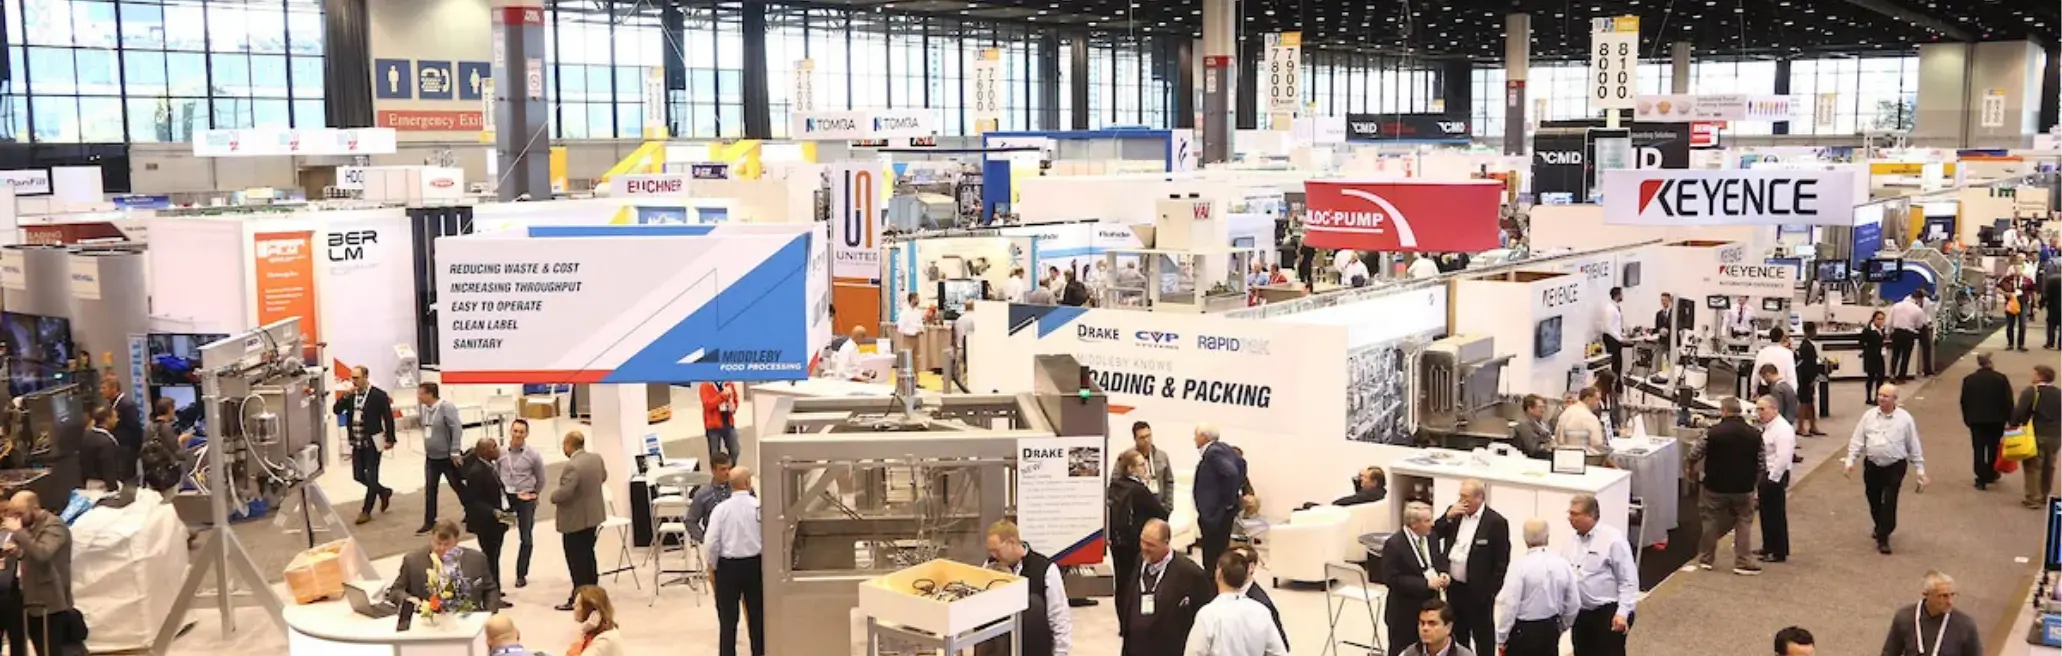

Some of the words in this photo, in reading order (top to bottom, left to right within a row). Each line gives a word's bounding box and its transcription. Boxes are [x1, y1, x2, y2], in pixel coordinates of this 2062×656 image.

[389, 113, 455, 129] Emergency
[460, 114, 483, 126] Exit
[1547, 152, 1582, 164] CMD
[1639, 178, 1818, 216] KEYENCE
[450, 263, 501, 274] REDUCING
[504, 263, 539, 274] WASTE
[542, 263, 549, 273] &
[553, 263, 580, 273] COST
[1719, 265, 1785, 279] KEYENCE
[450, 281, 511, 293] INCREASING
[514, 281, 582, 292] THROUGHPUT
[451, 301, 478, 312] EASY
[481, 301, 494, 312] TO
[497, 301, 542, 312] OPERATE
[452, 320, 485, 331] CLEAN
[487, 320, 518, 330] LABEL
[1077, 324, 1119, 340] DRAKE
[1135, 331, 1179, 343] CVP
[453, 338, 503, 349] SANITARY
[721, 350, 782, 362] MIDDLEBY
[1077, 353, 1128, 368] MIDDLEBY
[1133, 358, 1173, 371] KNOWS
[720, 363, 745, 371] FOOD
[747, 363, 801, 371] PROCESSING
[1089, 369, 1155, 396] OADING
[1161, 376, 1175, 399] &
[1182, 379, 1271, 408] PACKING
[1023, 448, 1064, 459] DRAKE
